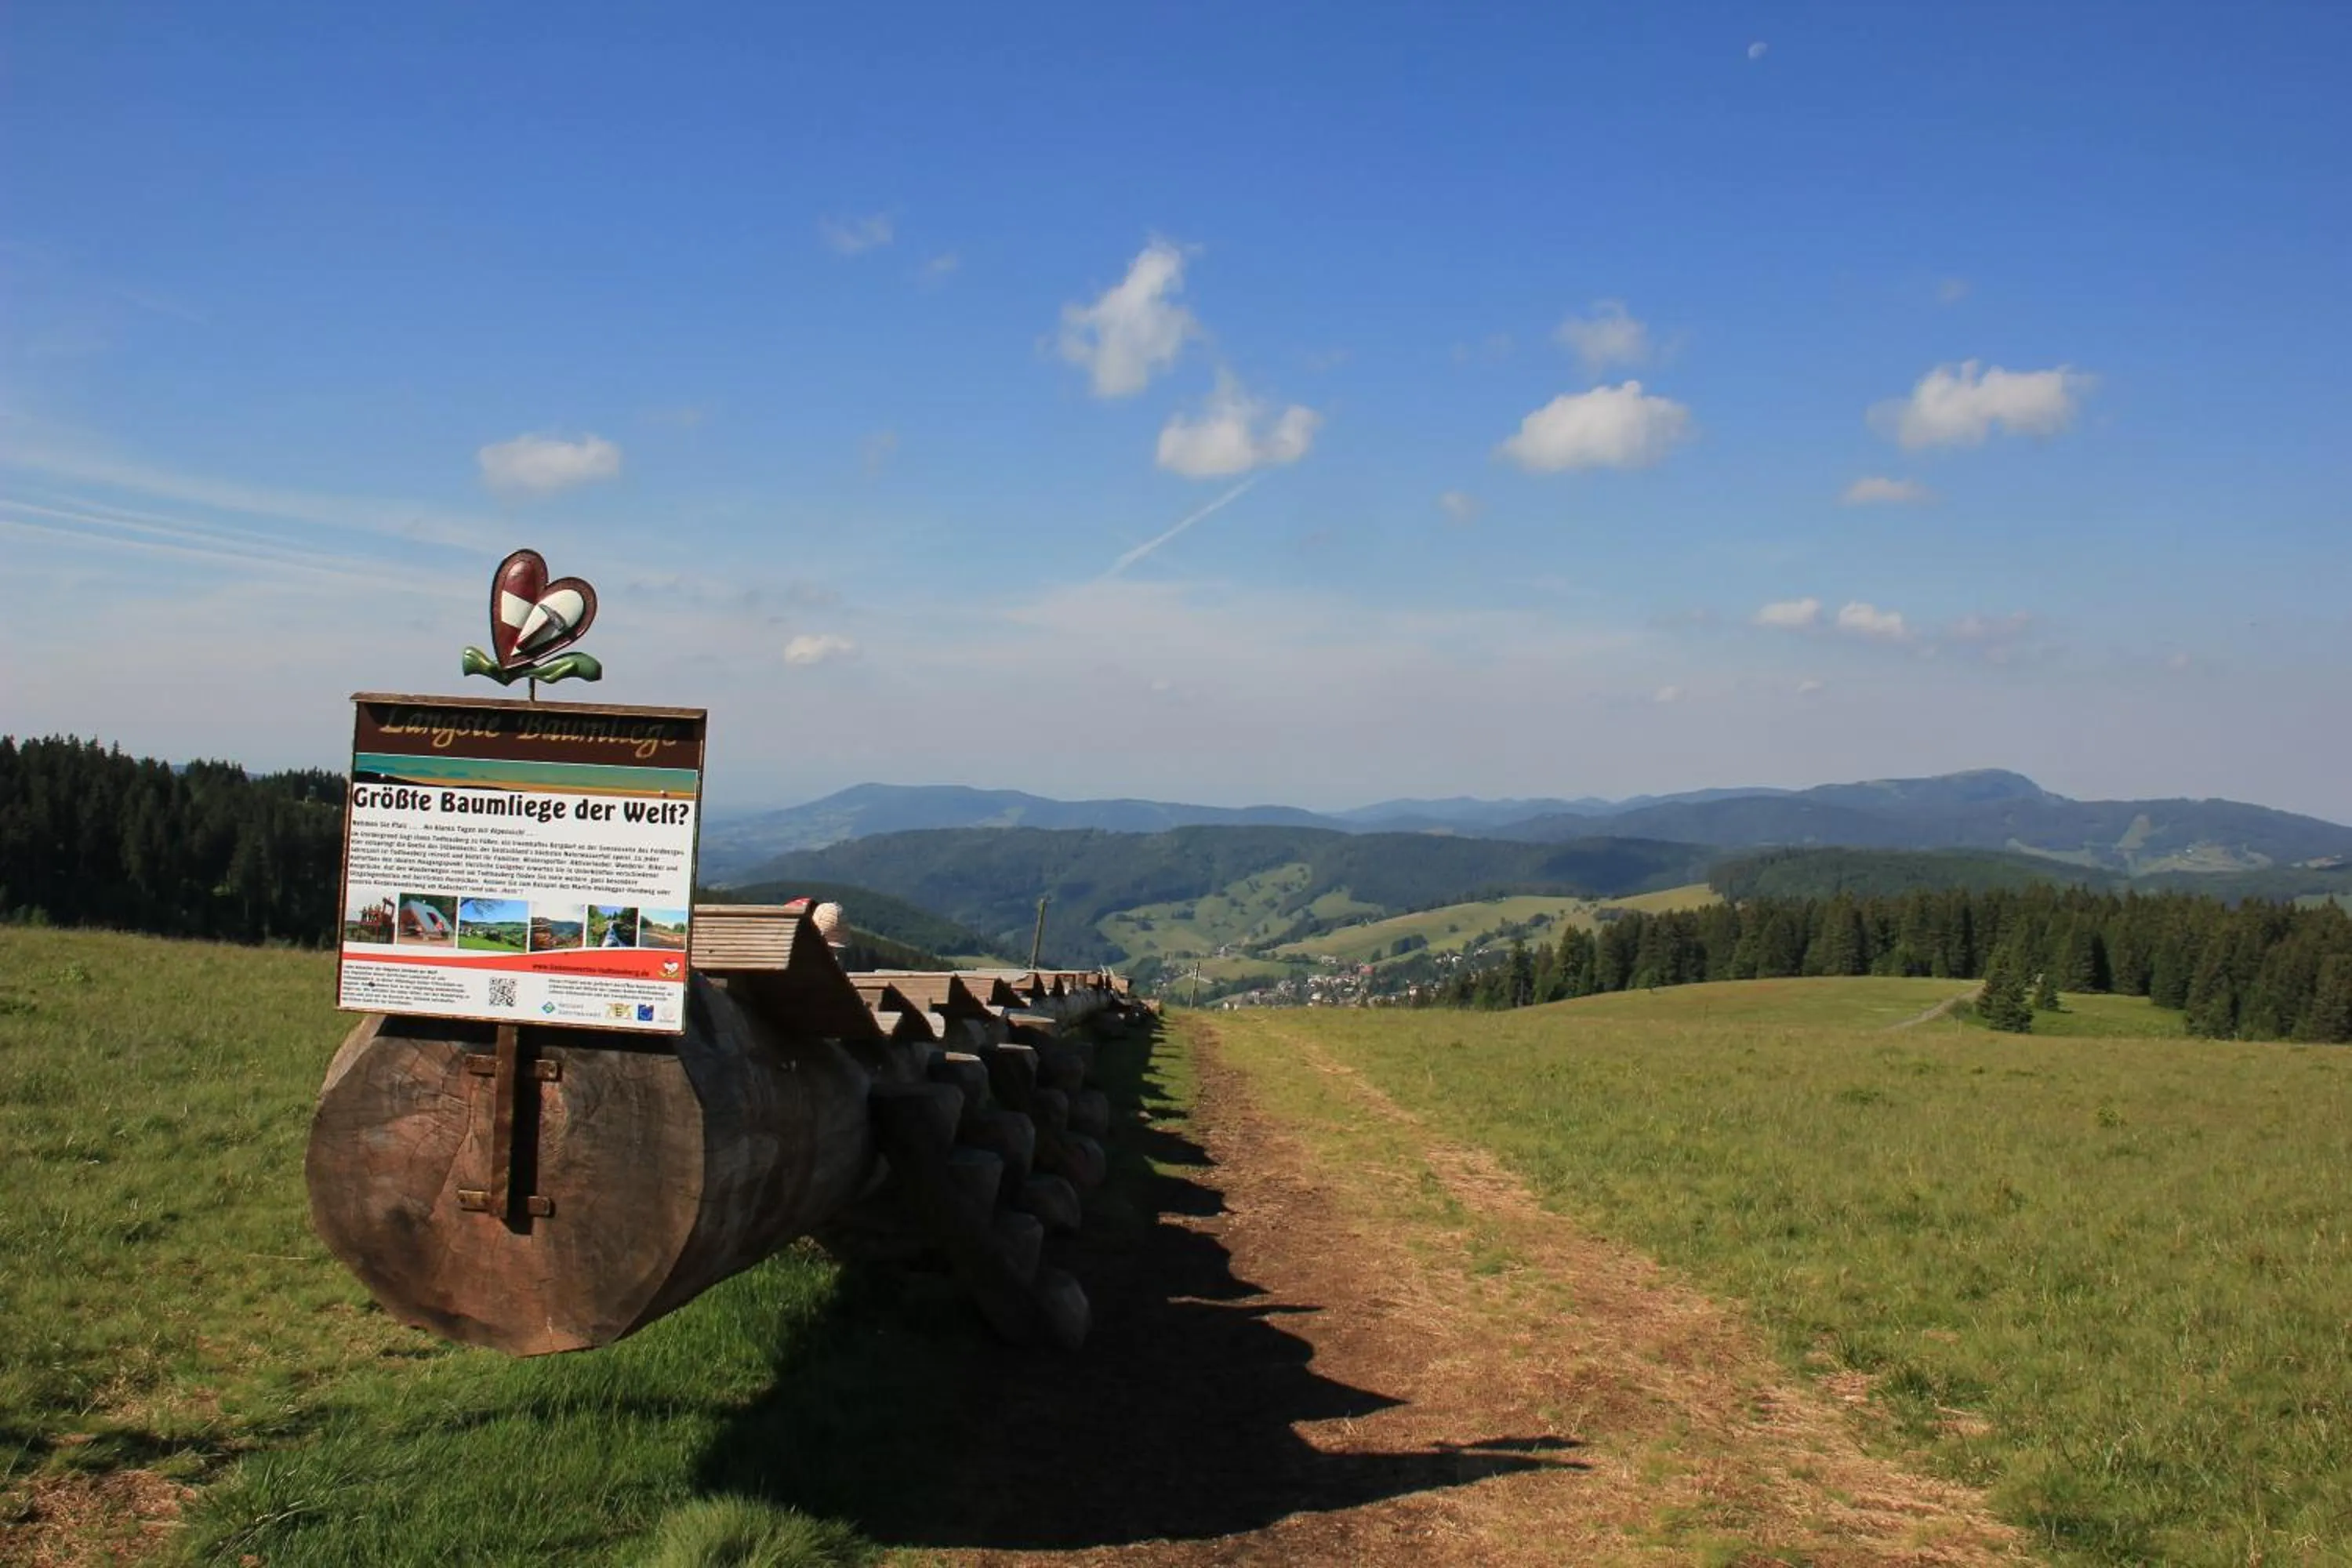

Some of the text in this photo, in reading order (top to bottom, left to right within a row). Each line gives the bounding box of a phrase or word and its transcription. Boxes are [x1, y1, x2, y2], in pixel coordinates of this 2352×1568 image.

[353, 786, 689, 826] Größte Baumliege der Welt?
